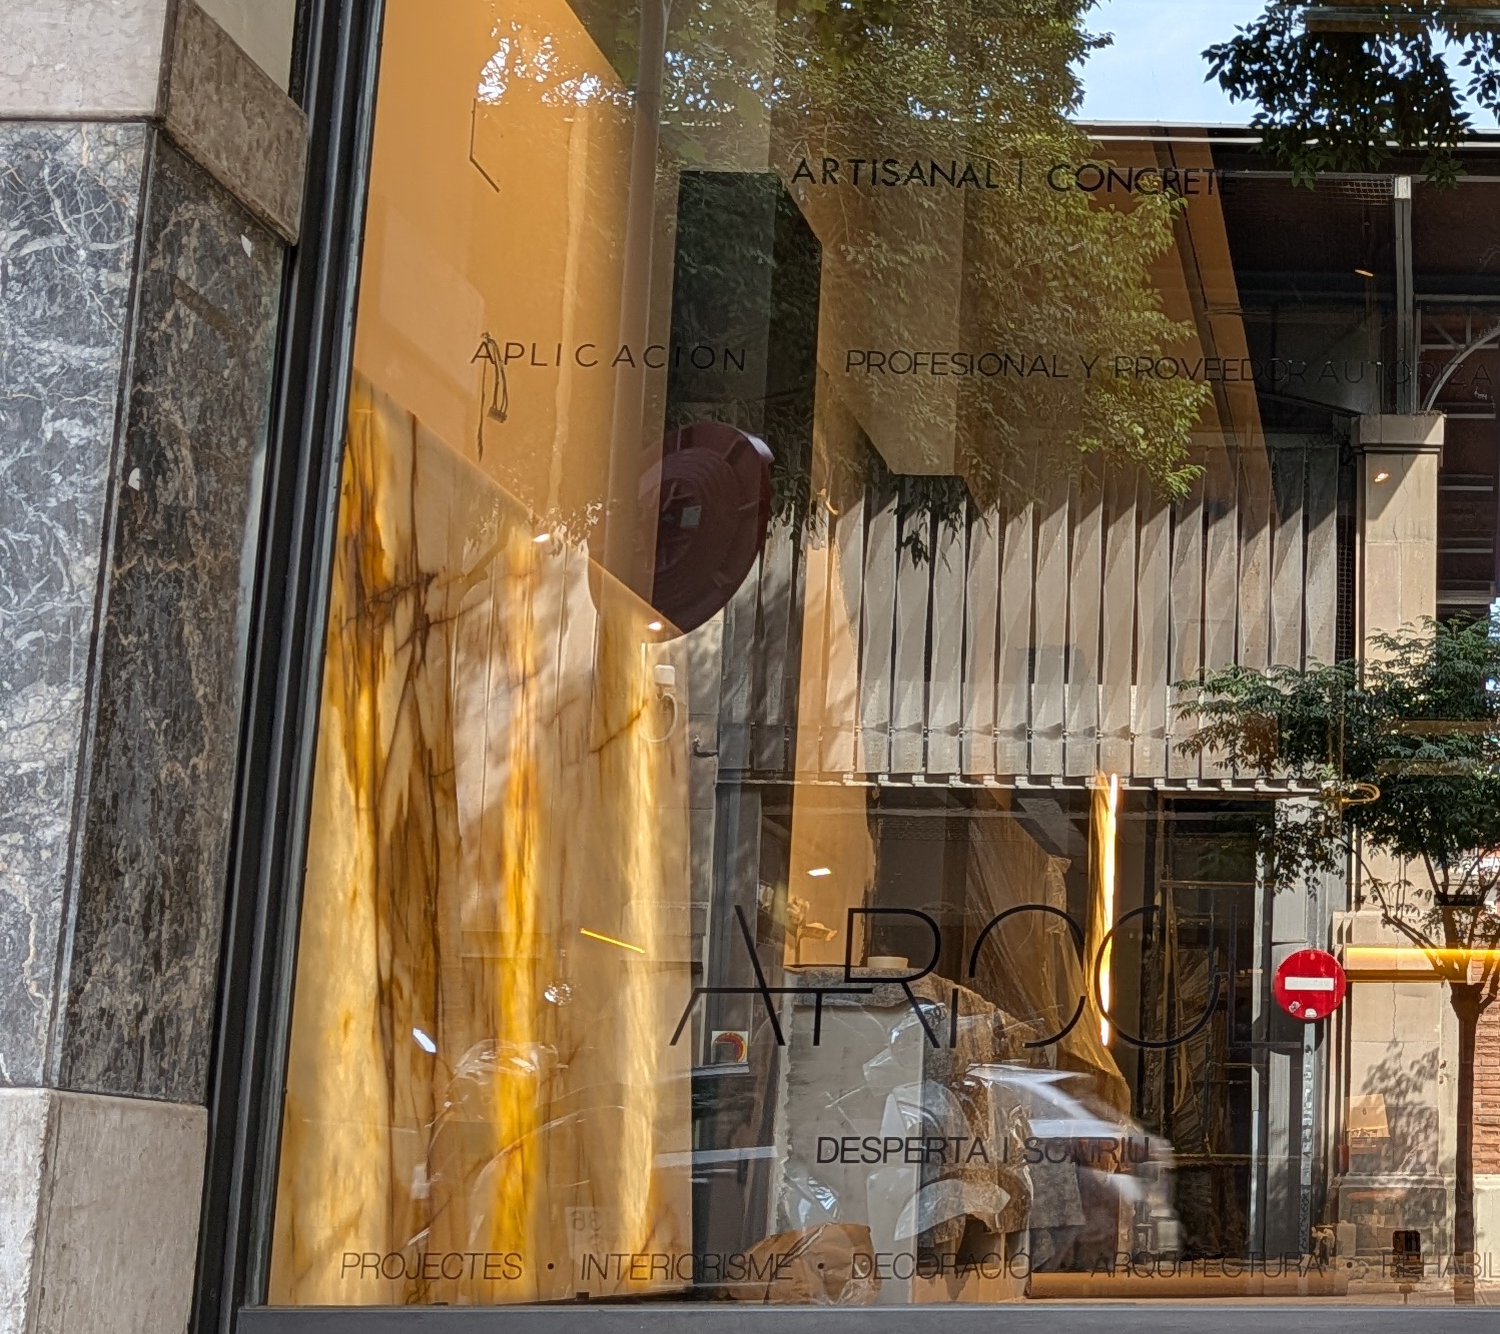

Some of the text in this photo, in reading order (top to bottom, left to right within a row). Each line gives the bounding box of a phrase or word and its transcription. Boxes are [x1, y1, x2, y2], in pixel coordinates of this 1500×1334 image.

[791, 157, 1238, 197] ARTISANAL CONCRETE
[845, 350, 1069, 378] PROFESIONAL
[1078, 354, 1100, 379] Y
[1115, 355, 1307, 382] PROVEEDOR
[816, 1136, 988, 1164] DESPERTA
[340, 1252, 523, 1281] PROJECTES
[580, 1253, 793, 1281] INTERIORISME
[1091, 1252, 1323, 1279] ARQUITECTURA
